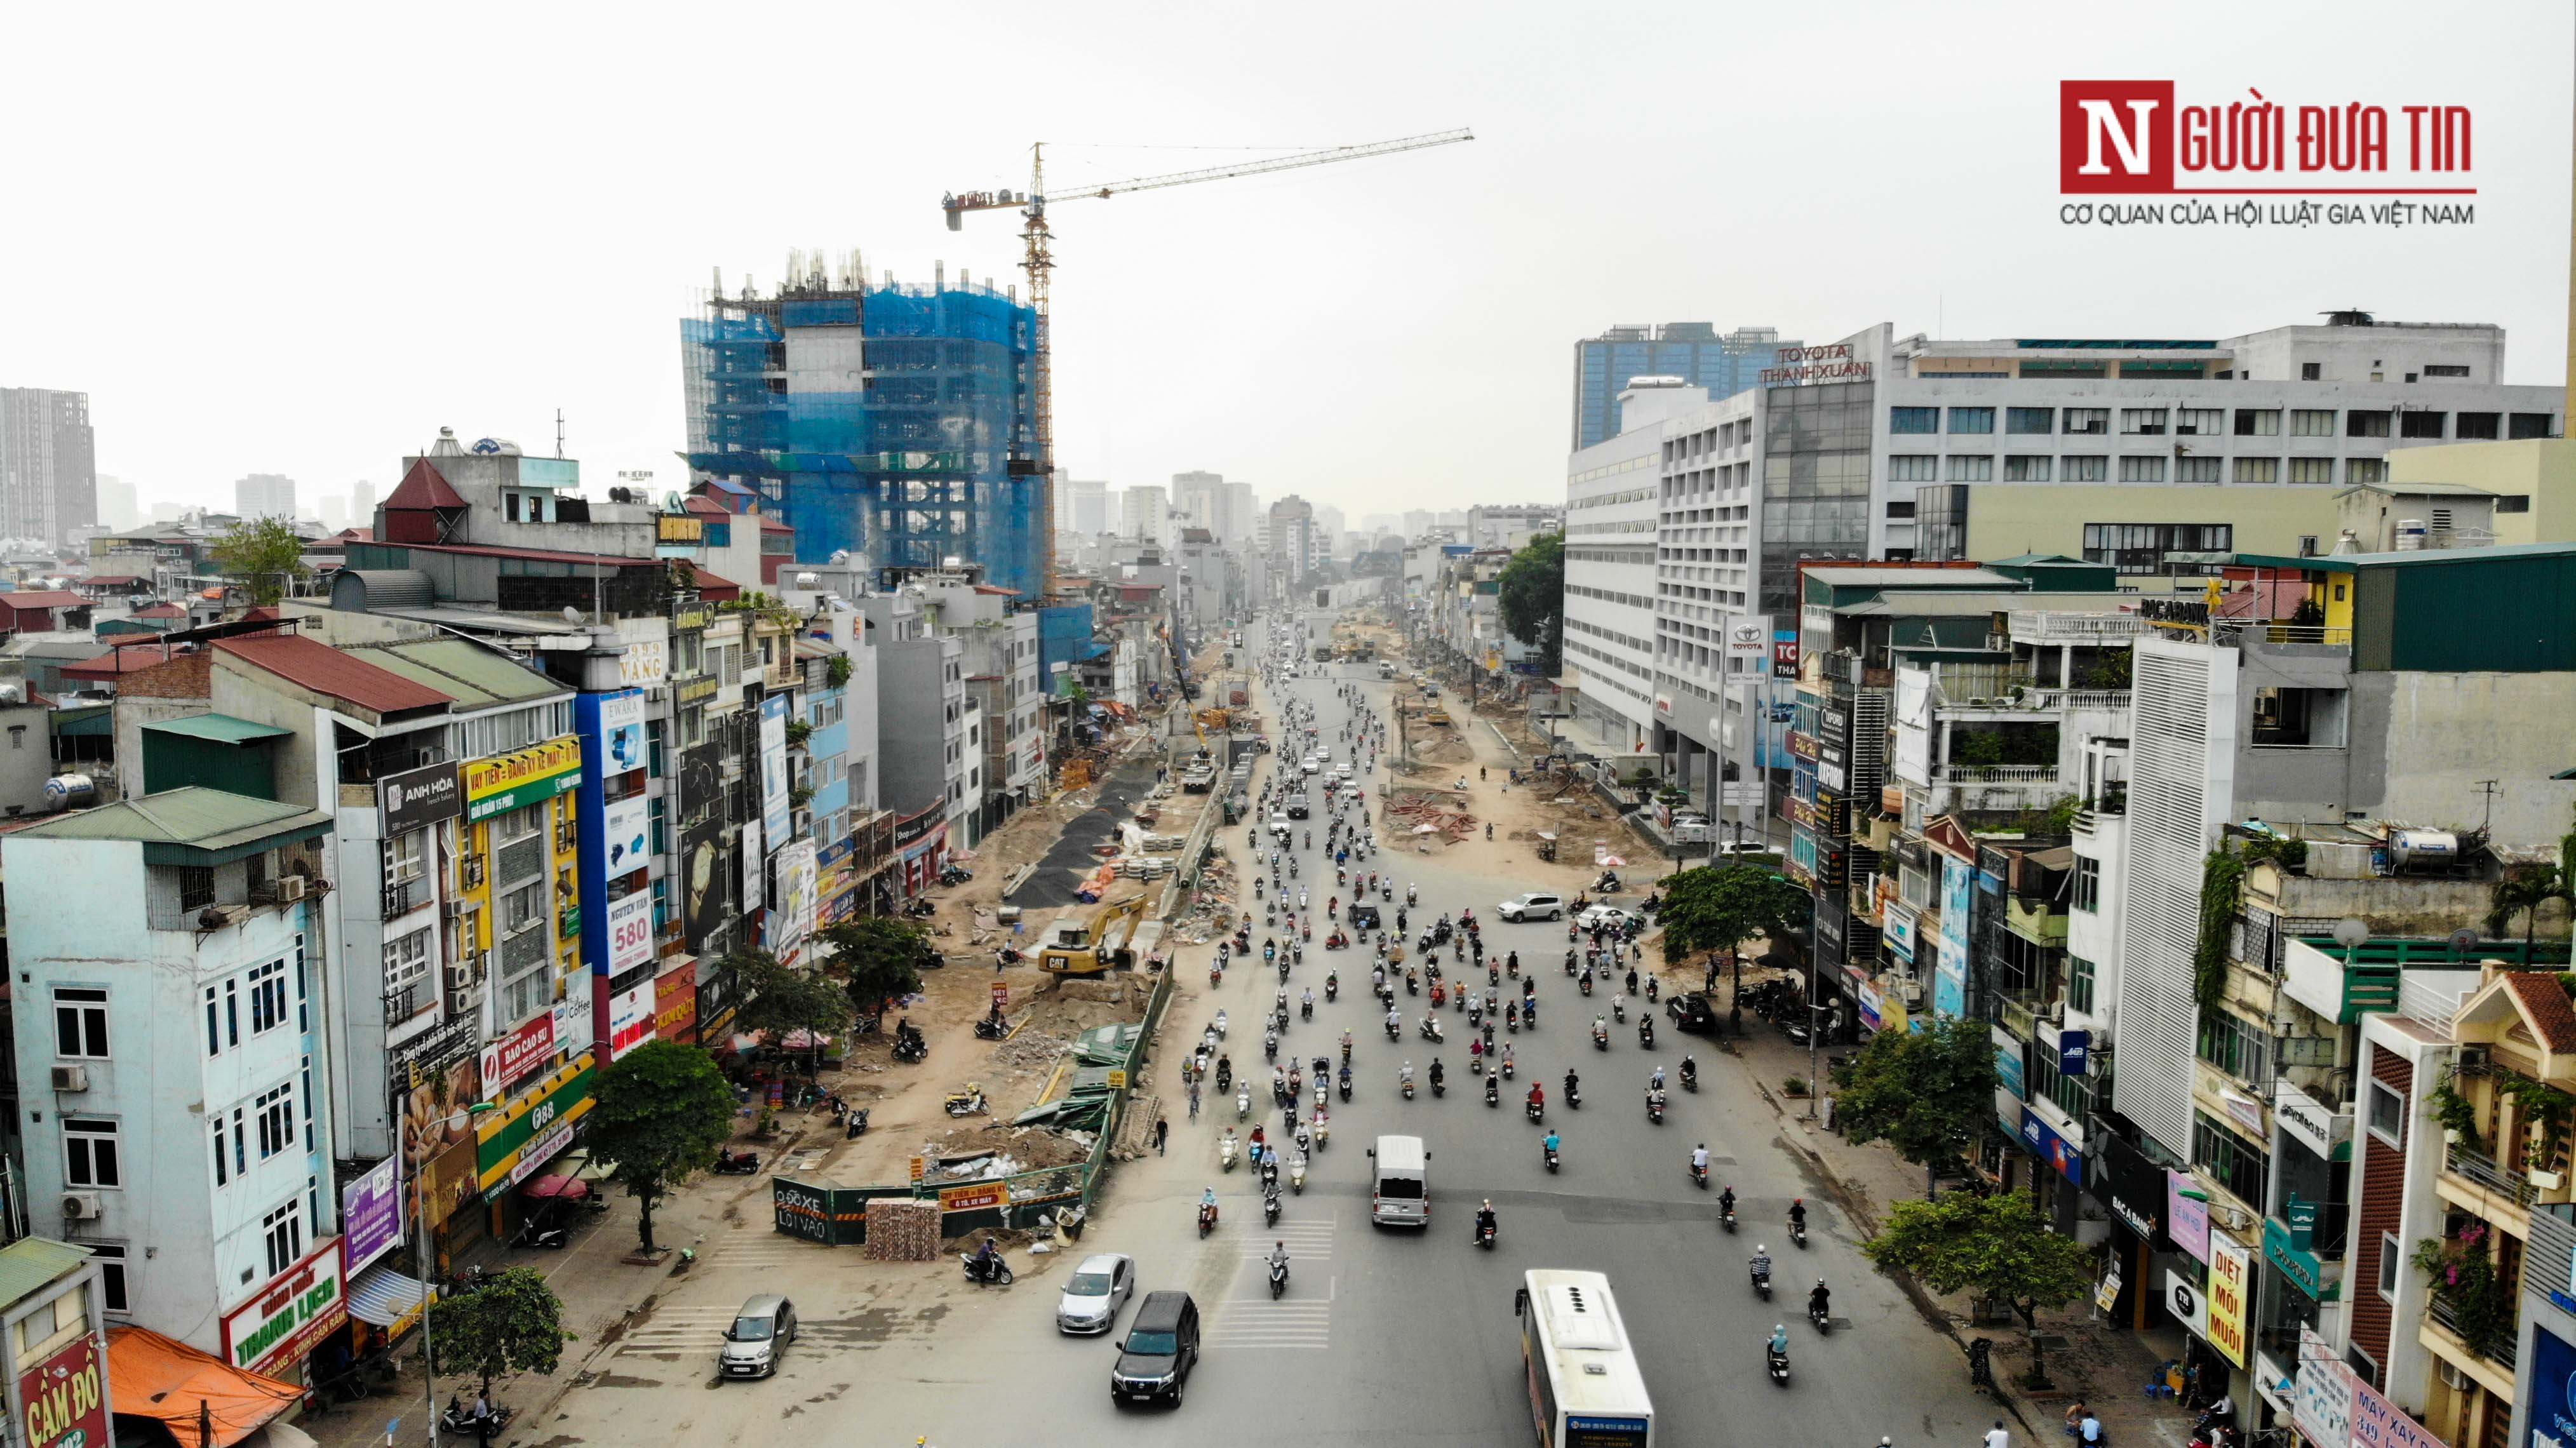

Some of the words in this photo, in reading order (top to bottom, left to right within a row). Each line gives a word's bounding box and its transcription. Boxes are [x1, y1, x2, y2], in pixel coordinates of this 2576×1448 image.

[1779, 345, 1848, 362] TOYOTA
[406, 784, 429, 802] ANH
[431, 777, 454, 794] HÒA
[471, 772, 483, 791] VAY
[538, 754, 546, 769] XE
[1818, 761, 1843, 791] OXFORD
[495, 799, 502, 810] 15
[615, 917, 647, 953] 580
[1049, 957, 1065, 969] CAT
[569, 998, 590, 1019] Coffee
[504, 1044, 520, 1065] BAO
[521, 1034, 537, 1054] CAO
[537, 1027, 547, 1043] SU
[2025, 1120, 2039, 1141] MB
[802, 1195, 820, 1213] XE
[2112, 1196, 2126, 1216] BAC
[2126, 1208, 2131, 1221] A
[2131, 1212, 2150, 1237] BANK
[800, 1212, 824, 1238] VÀO
[2215, 1249, 2241, 1286] DIỆT
[2215, 1284, 2239, 1320] MỐI
[236, 1305, 295, 1366] THANH
[297, 1275, 335, 1322] LỊCH
[293, 1338, 312, 1357] KÍNH
[329, 1310, 346, 1330] RÂM
[2210, 1313, 2241, 1355] MUỖI
[28, 1367, 71, 1448] CẦM
[71, 1337, 99, 1421] ĐỒ
[2357, 1412, 2378, 1441] 349
[2359, 1391, 2385, 1421] MÁY
[2390, 1415, 2417, 1445] XÂY
